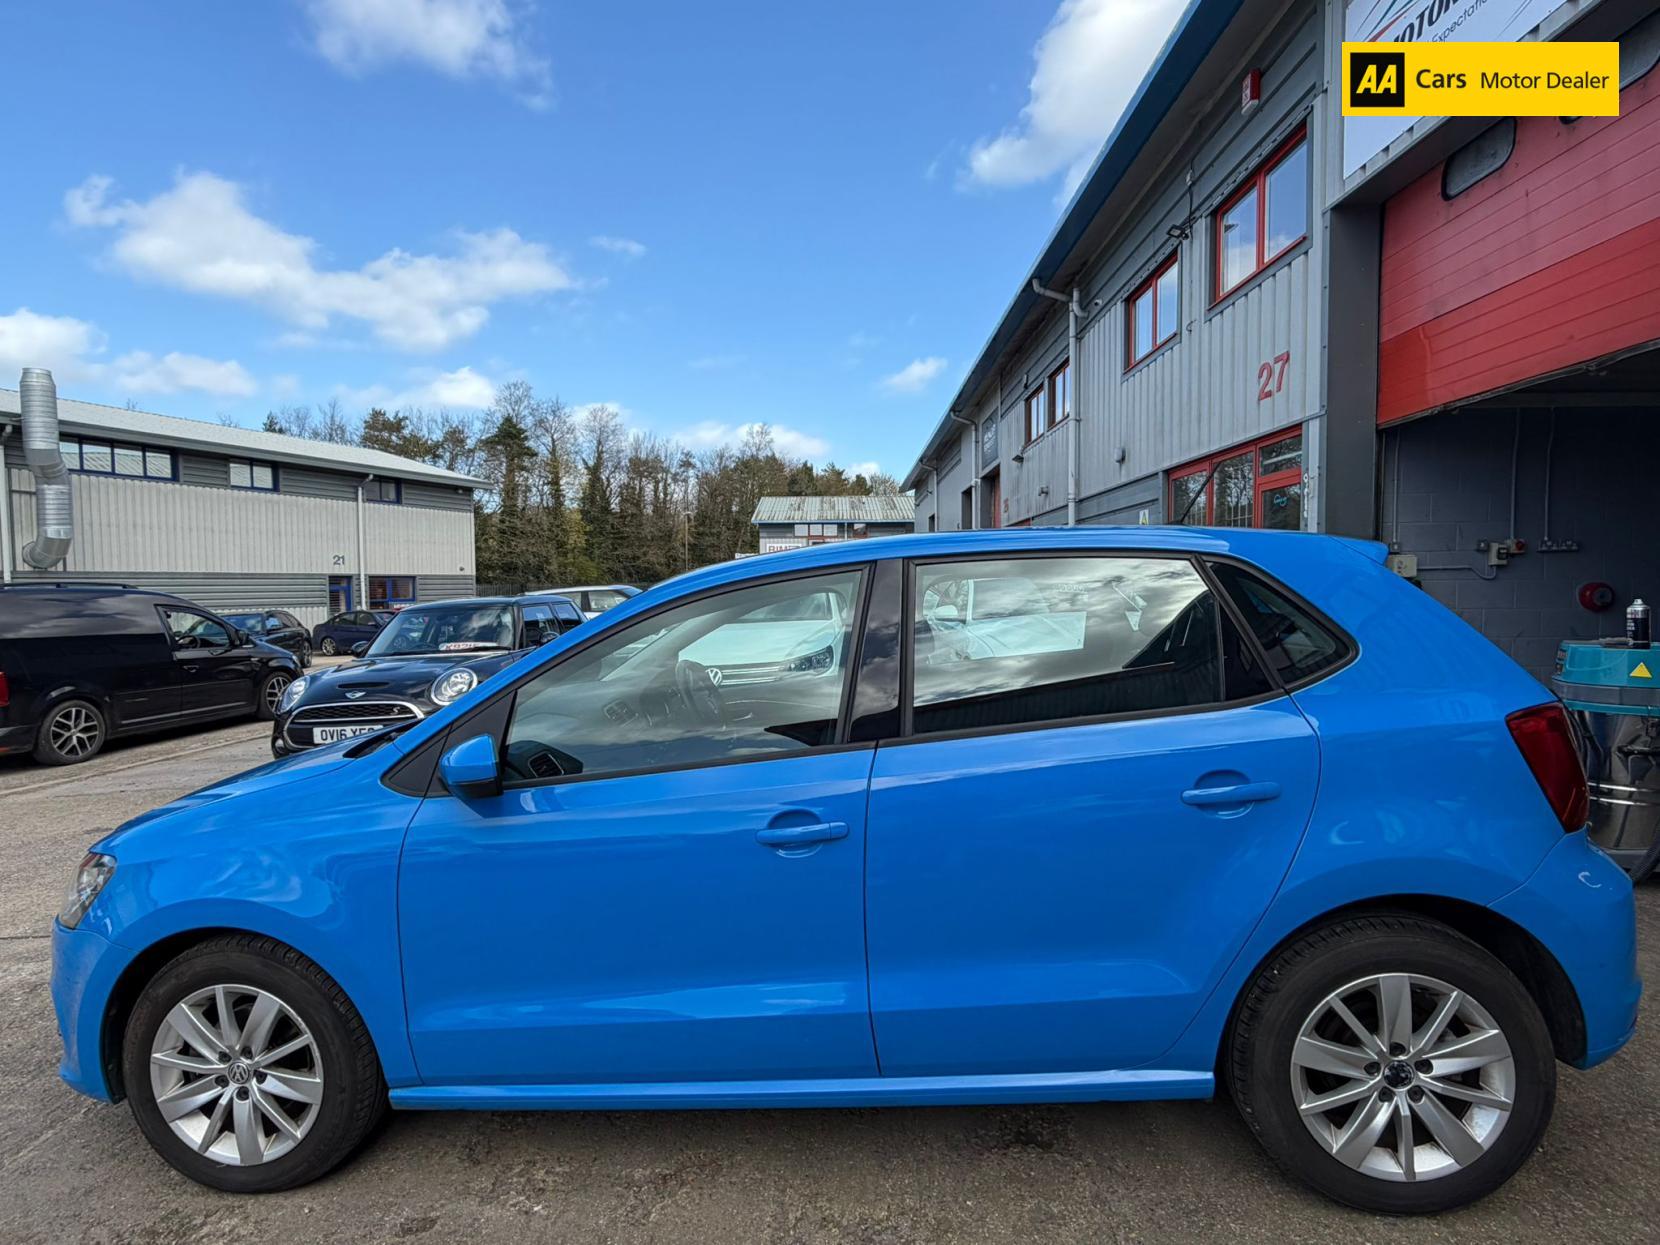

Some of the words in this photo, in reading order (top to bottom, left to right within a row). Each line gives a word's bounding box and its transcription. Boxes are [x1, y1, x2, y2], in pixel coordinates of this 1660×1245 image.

[1258, 350, 1290, 401] 27
[333, 555, 345, 565] 21
[320, 729, 347, 741] OV16
